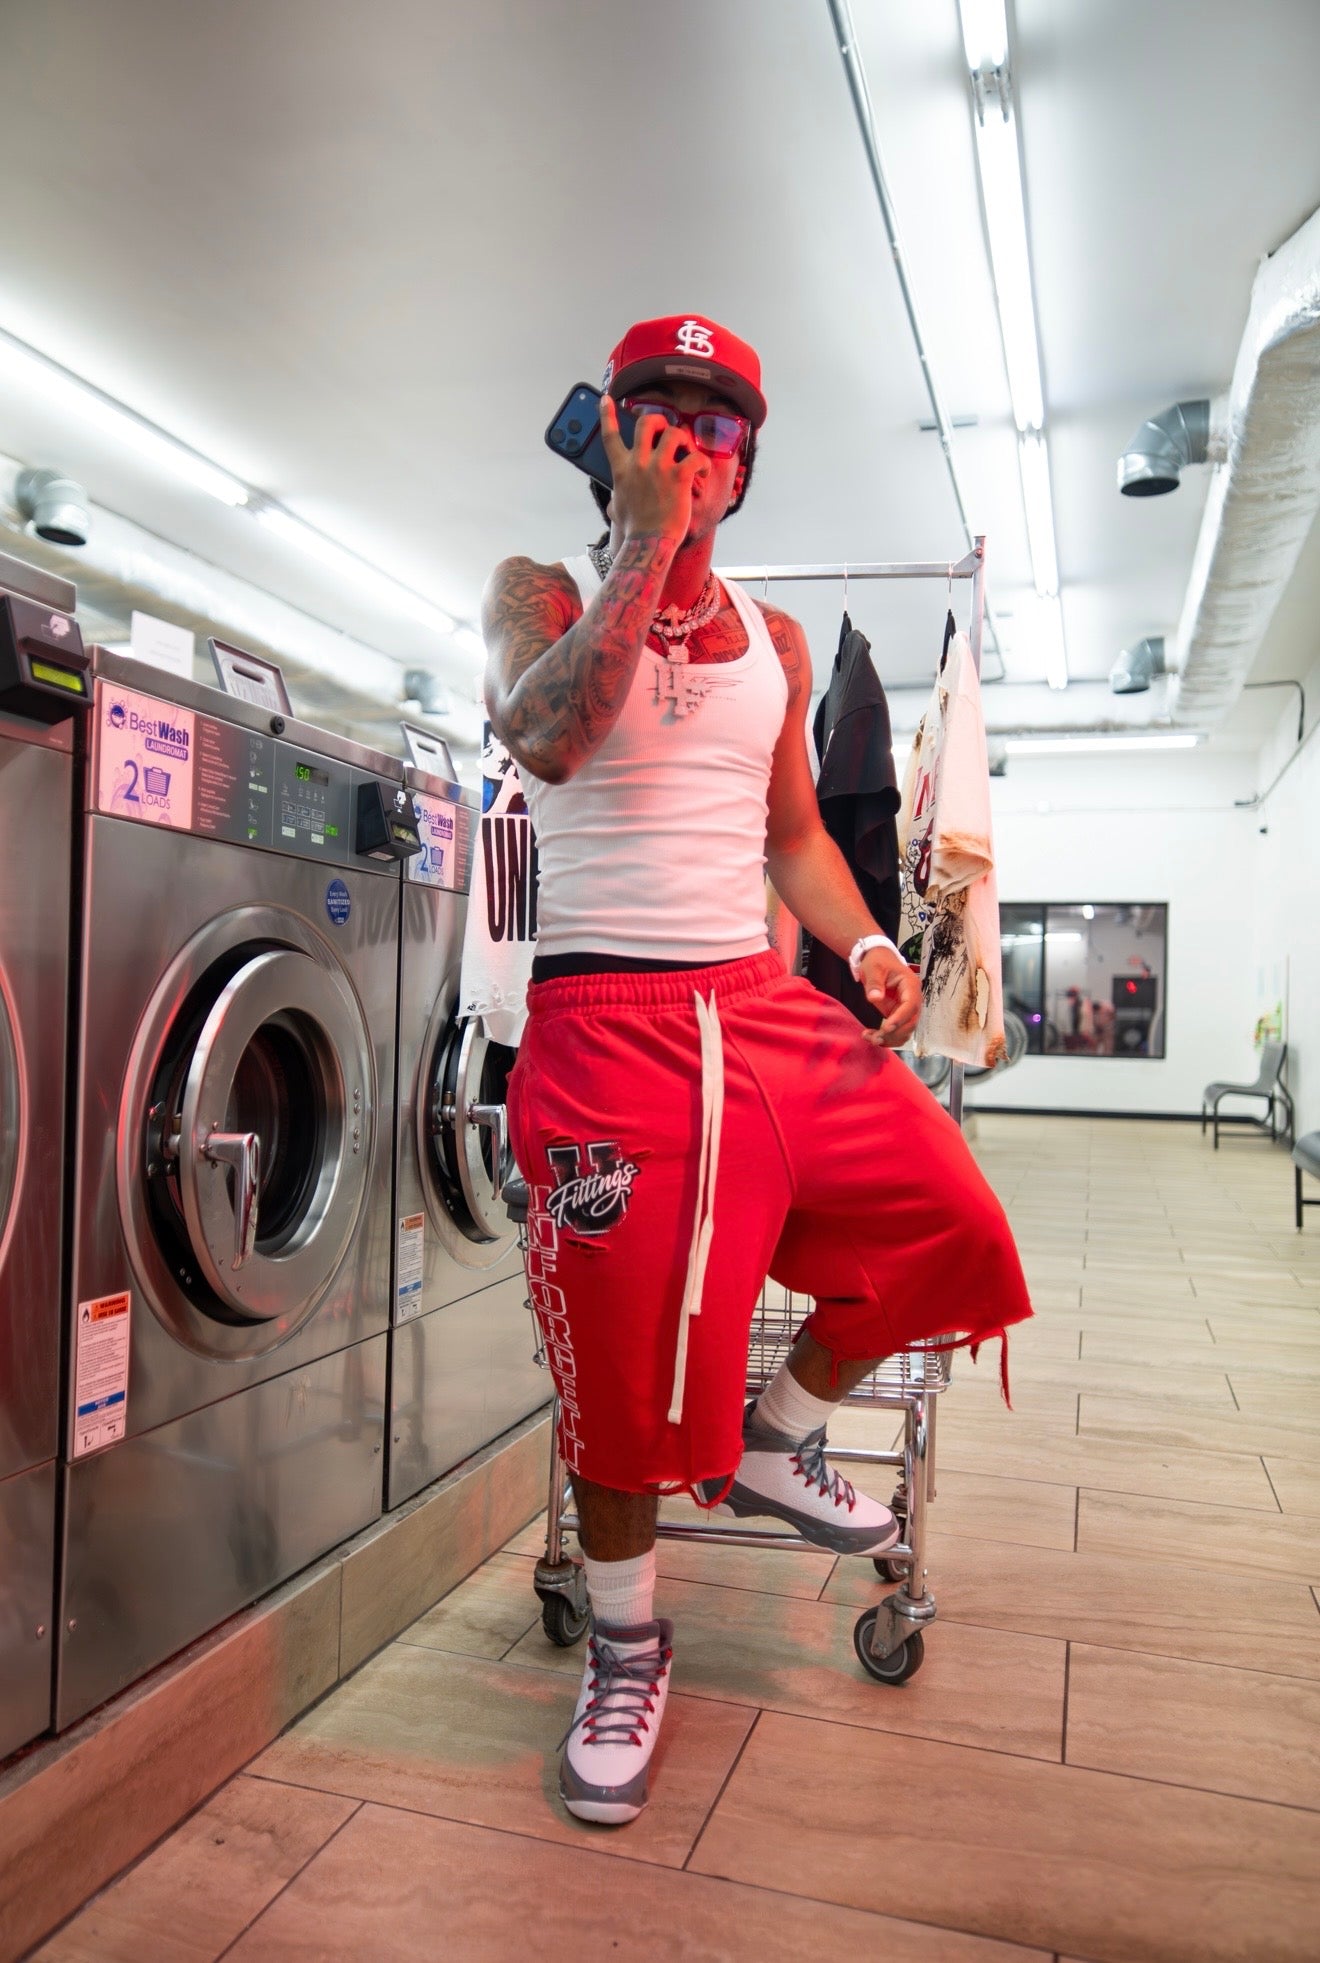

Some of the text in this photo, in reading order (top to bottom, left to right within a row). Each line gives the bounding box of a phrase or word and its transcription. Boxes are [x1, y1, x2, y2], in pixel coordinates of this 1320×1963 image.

[146, 739, 187, 760] LAUNDROMAT
[123, 759, 139, 802] 2
[141, 793, 171, 811] LOADS
[420, 842, 429, 872] 2
[546, 1163, 639, 1228] Fittings
